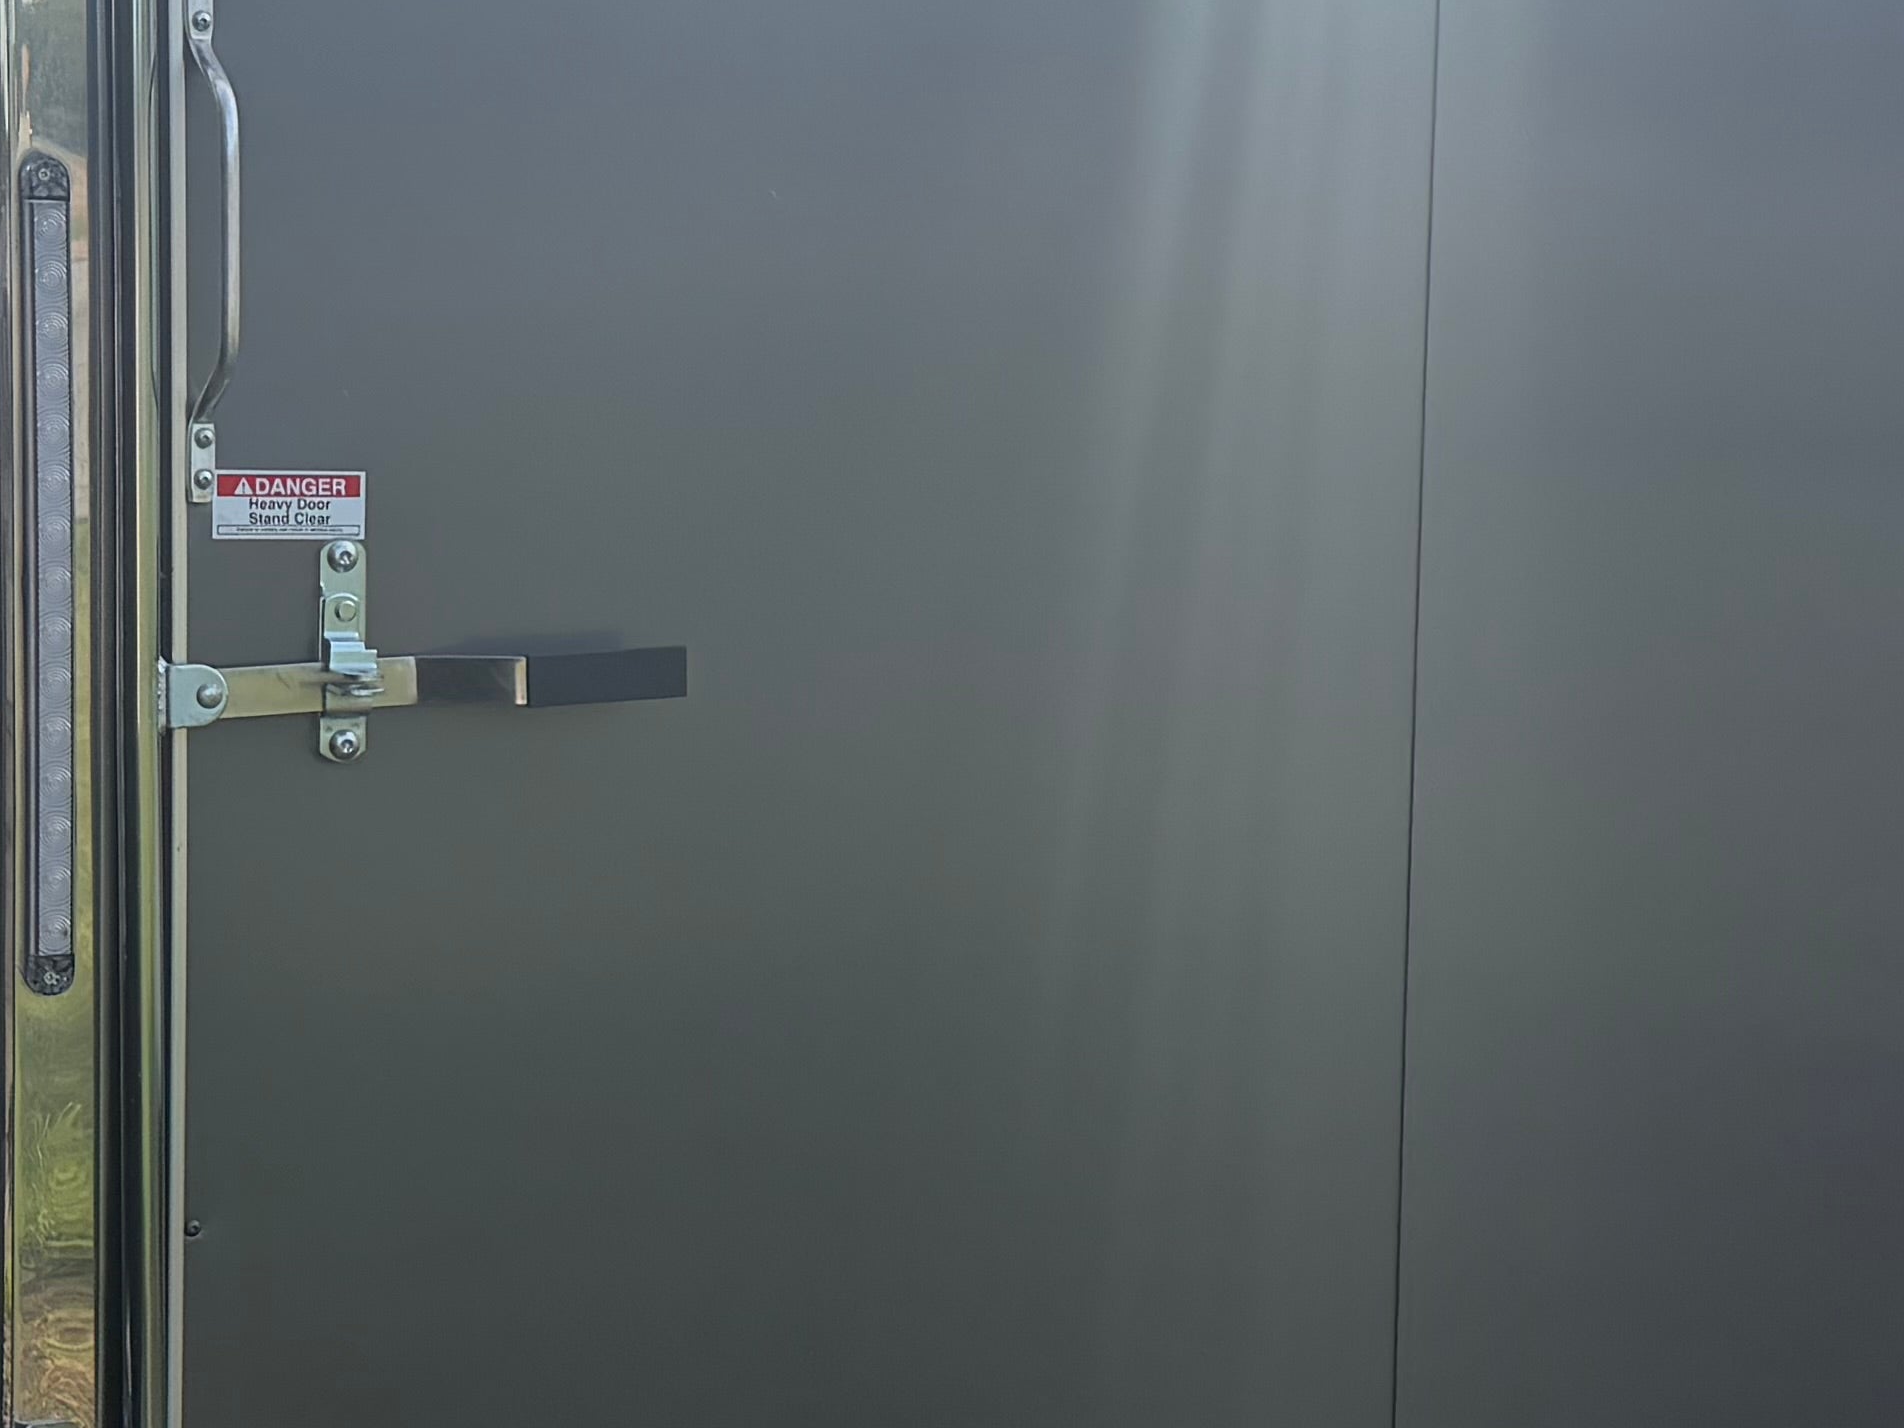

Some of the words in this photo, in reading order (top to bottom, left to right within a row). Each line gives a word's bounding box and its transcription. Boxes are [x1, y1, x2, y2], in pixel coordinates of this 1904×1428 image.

[255, 477, 347, 496] DANGER
[248, 498, 292, 514] Heavy
[296, 498, 331, 510] Door
[248, 512, 290, 525] Stand
[295, 512, 331, 525] Clear
